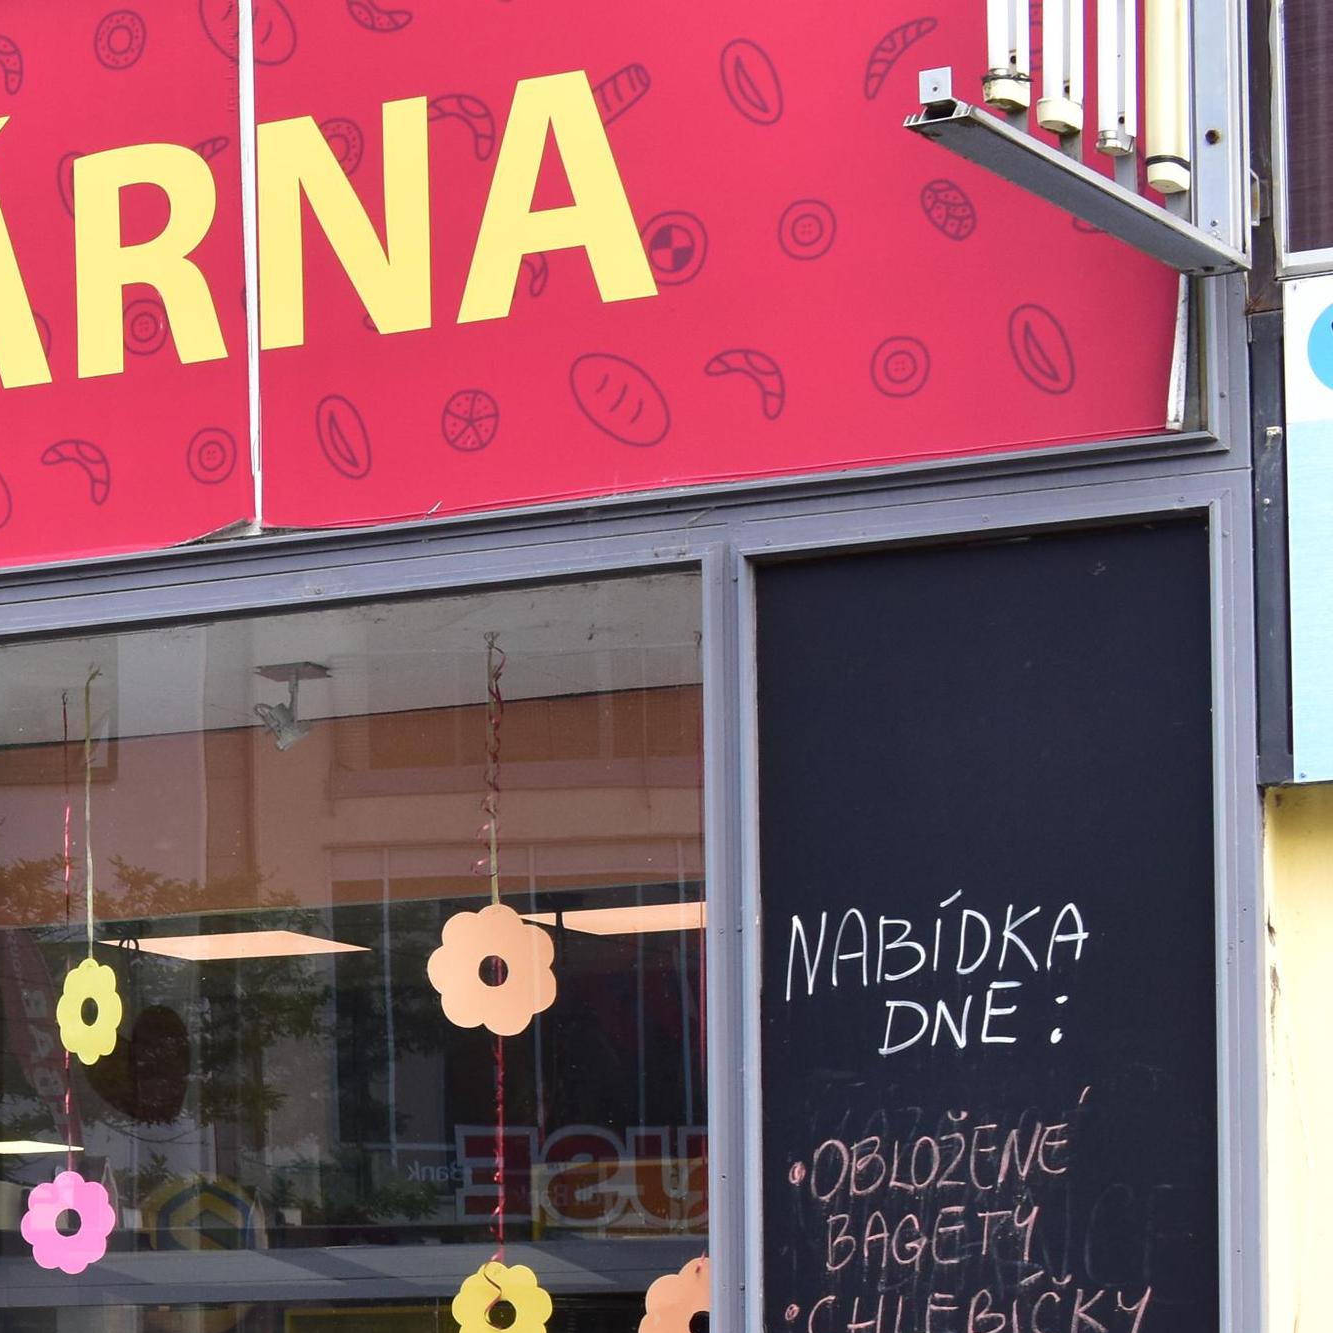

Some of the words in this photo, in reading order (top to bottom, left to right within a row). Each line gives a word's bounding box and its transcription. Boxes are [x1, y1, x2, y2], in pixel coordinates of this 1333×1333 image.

[785, 889, 1090, 1001] NABÍDKA
[810, 1085, 1091, 1201] OBLOŽENÉ
[826, 1205, 1040, 1271] BAGETY
